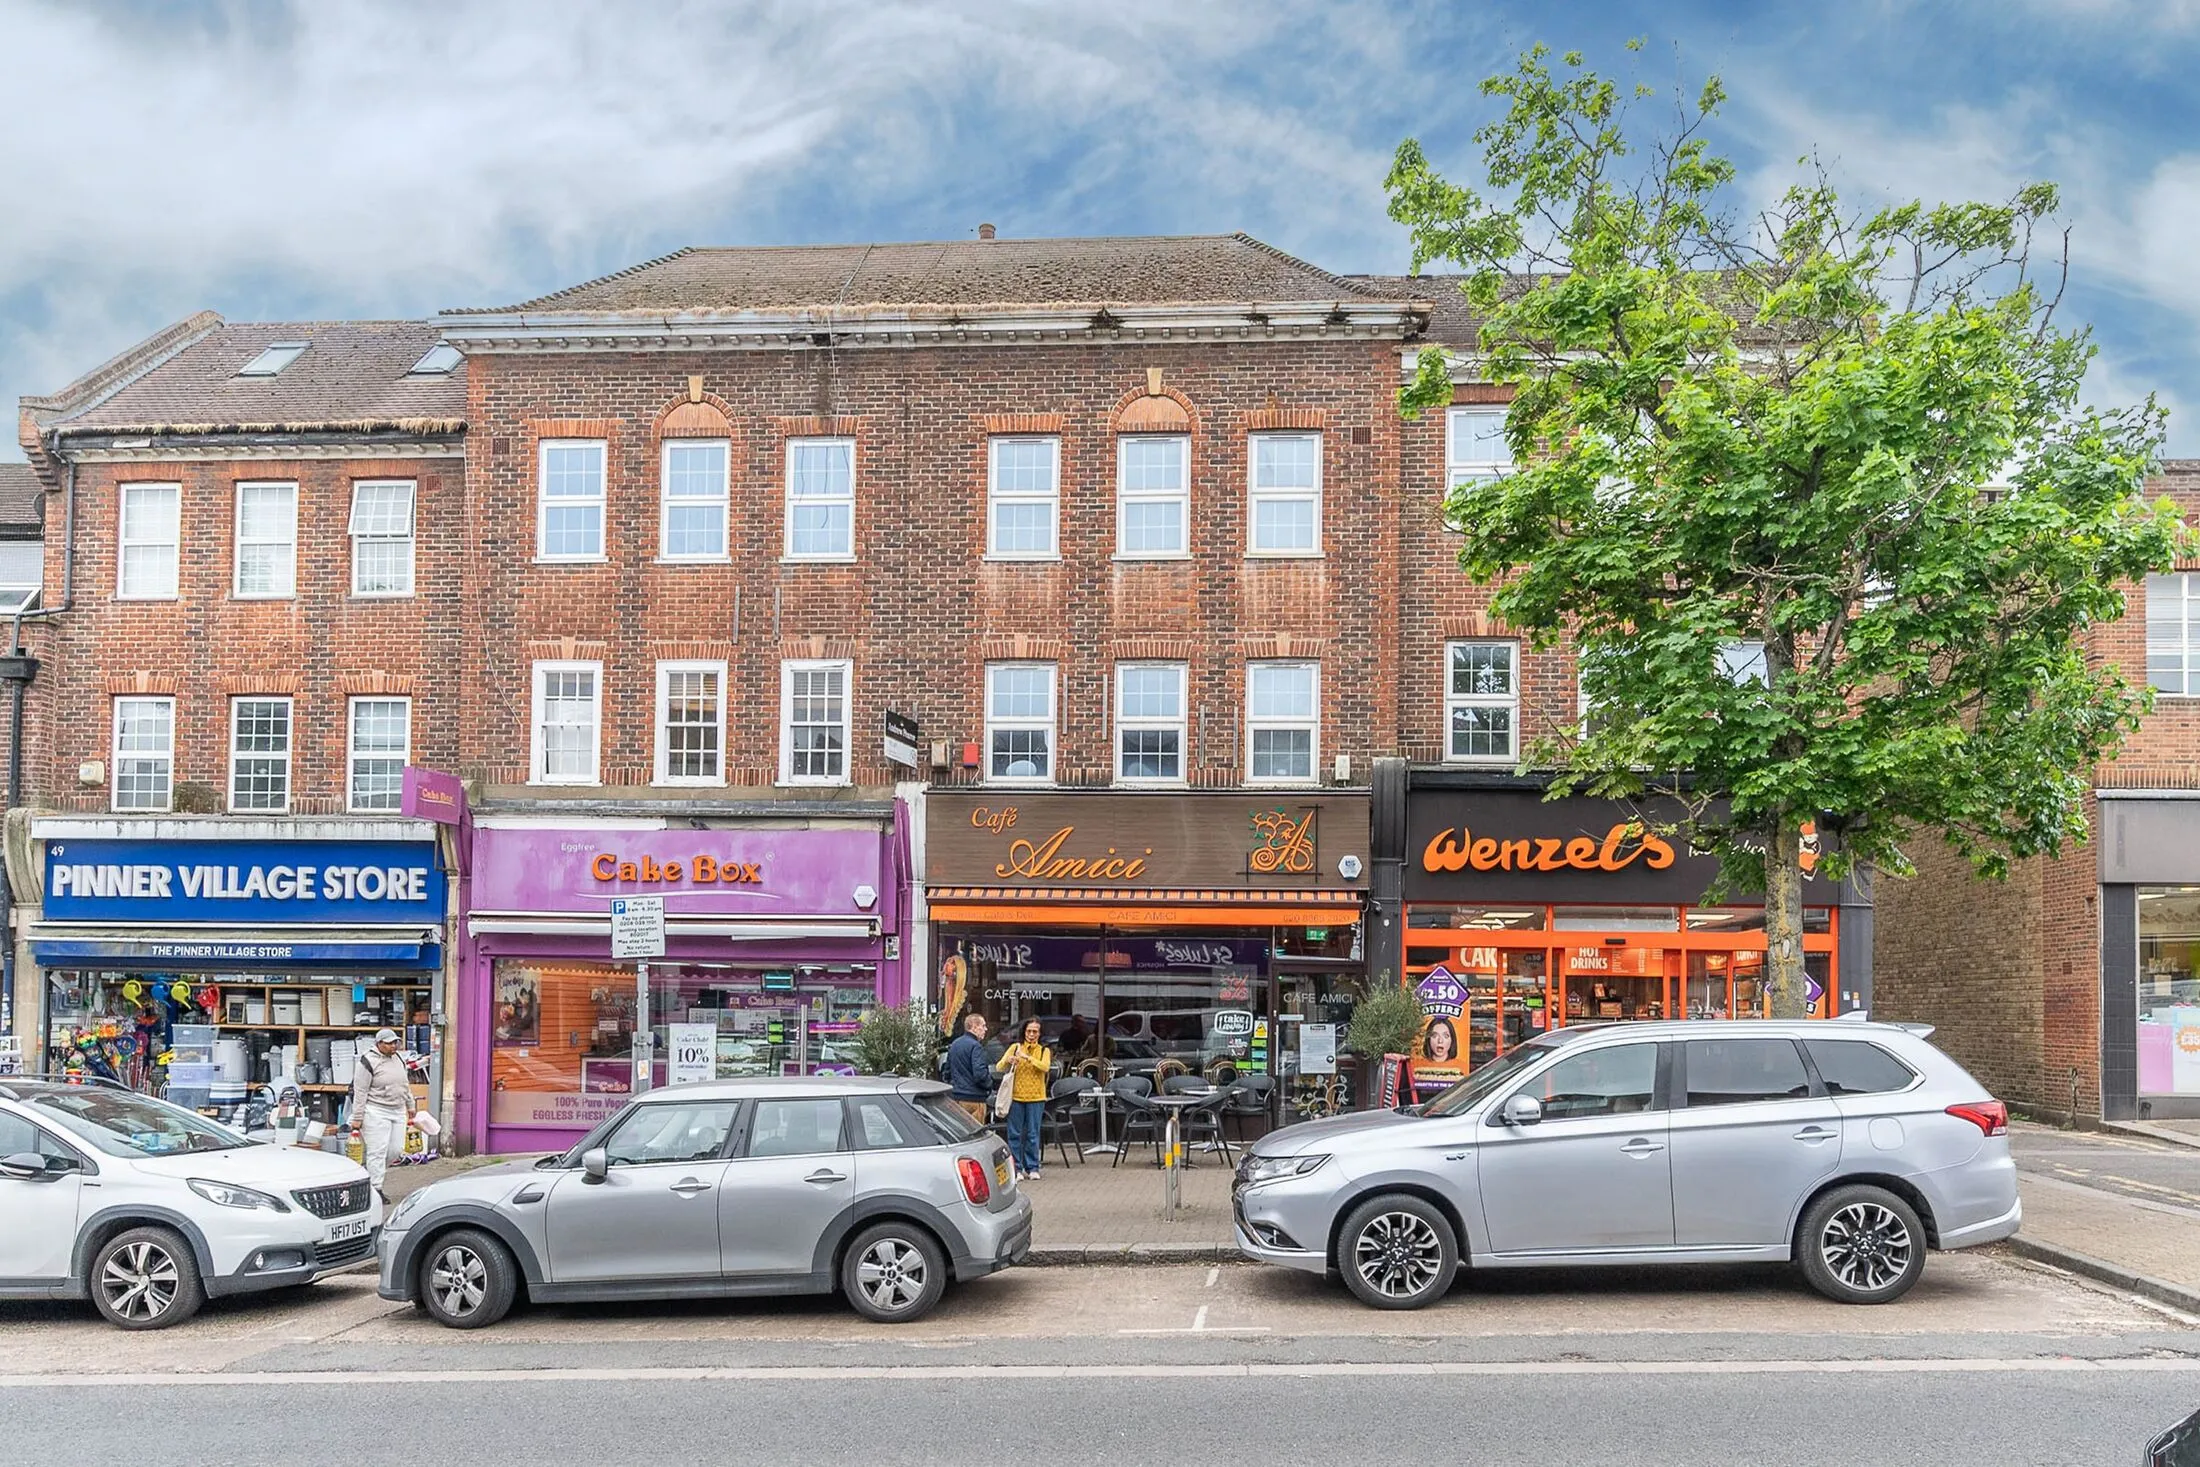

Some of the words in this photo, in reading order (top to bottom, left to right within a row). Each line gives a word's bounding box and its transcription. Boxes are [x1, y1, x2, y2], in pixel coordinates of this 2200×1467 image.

[971, 807, 1018, 834] Café
[51, 845, 65, 857] 49
[561, 842, 595, 852] Eggfree
[995, 826, 1152, 878] Amici
[1423, 821, 1675, 872] Wenzel's
[591, 853, 683, 883] Cake
[691, 854, 763, 883] Box
[52, 864, 173, 898] PINNER
[178, 865, 317, 900] VILLAGE
[323, 865, 428, 900] STORE
[1107, 911, 1140, 921] CAFE
[1143, 911, 1178, 921] AMICI
[152, 945, 172, 956] THE
[174, 945, 211, 957] PINNER
[213, 946, 257, 957] VILLAGE
[258, 946, 292, 957] STORE
[1570, 957, 1608, 970] DRINKS
[984, 989, 1016, 1000] CAFE
[1019, 989, 1052, 1000] AMICI
[1283, 992, 1316, 1003] CAFE
[1319, 993, 1353, 1003] AMICI
[1421, 1004, 1461, 1017] OFFERS
[1223, 1014, 1245, 1023] take
[677, 1047, 709, 1063] 10%
[599, 1080, 628, 1092] Cake
[555, 1096, 579, 1108] 100%
[582, 1097, 602, 1108] Pure
[533, 1110, 573, 1121] EGGLESS
[576, 1110, 606, 1121] FRESH
[331, 1223, 350, 1241] HF17
[351, 1220, 367, 1236] UST
